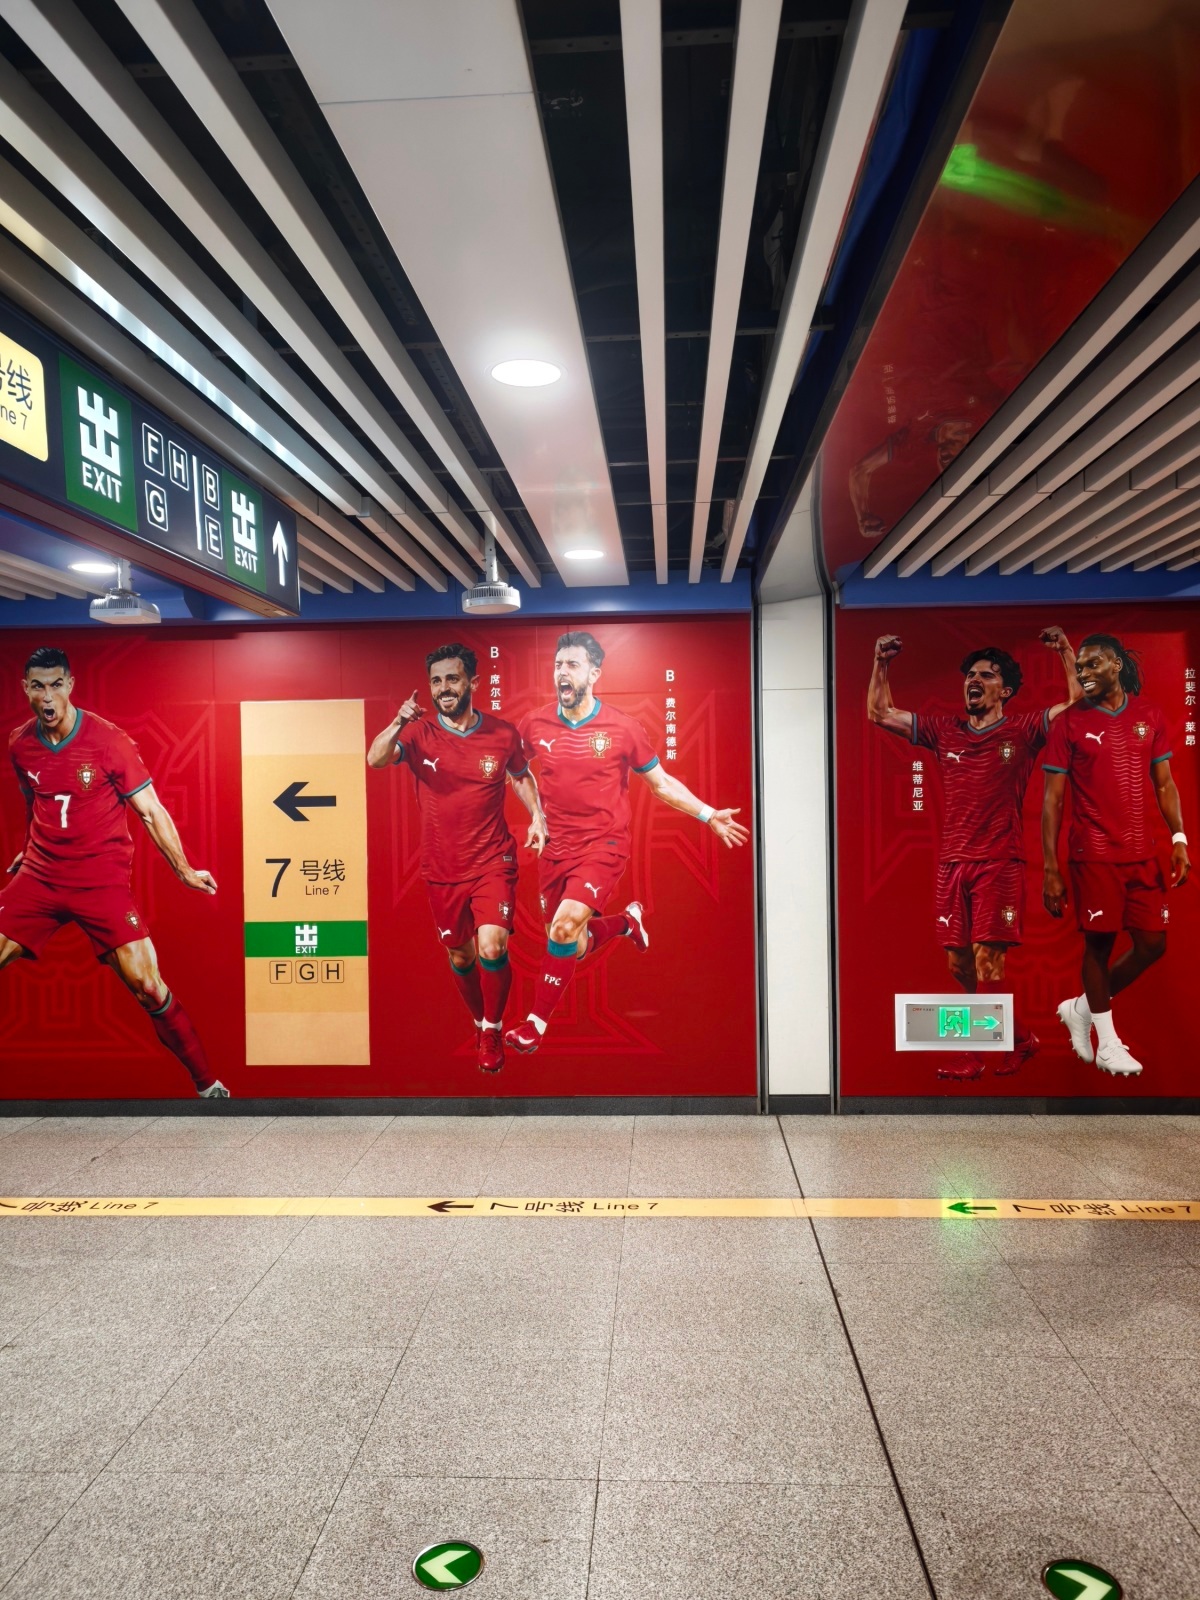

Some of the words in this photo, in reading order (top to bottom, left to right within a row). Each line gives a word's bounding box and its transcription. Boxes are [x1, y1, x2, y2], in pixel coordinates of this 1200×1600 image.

[0, 353, 33, 410] 线
[20, 412, 28, 430] 7
[147, 432, 159, 463] F
[172, 449, 186, 483] H
[82, 461, 122, 503] EXIT
[206, 471, 216, 503] B
[150, 489, 165, 523] G
[208, 521, 220, 553] E
[234, 545, 259, 574] EXIT
[912, 760, 924, 811] 维蒂尼亚
[54, 794, 72, 828] 7
[305, 885, 330, 896] Line
[333, 885, 340, 896] 7
[295, 946, 318, 954] EXIT
[275, 963, 287, 980] F
[299, 963, 315, 980] G
[326, 963, 340, 980] H
[89, 1201, 138, 1211] Line
[143, 1201, 159, 1210] 7
[593, 1202, 641, 1211] Line
[648, 1202, 660, 1211] 7
[1120, 1204, 1175, 1214] Line
[1177, 1205, 1192, 1214] 7
